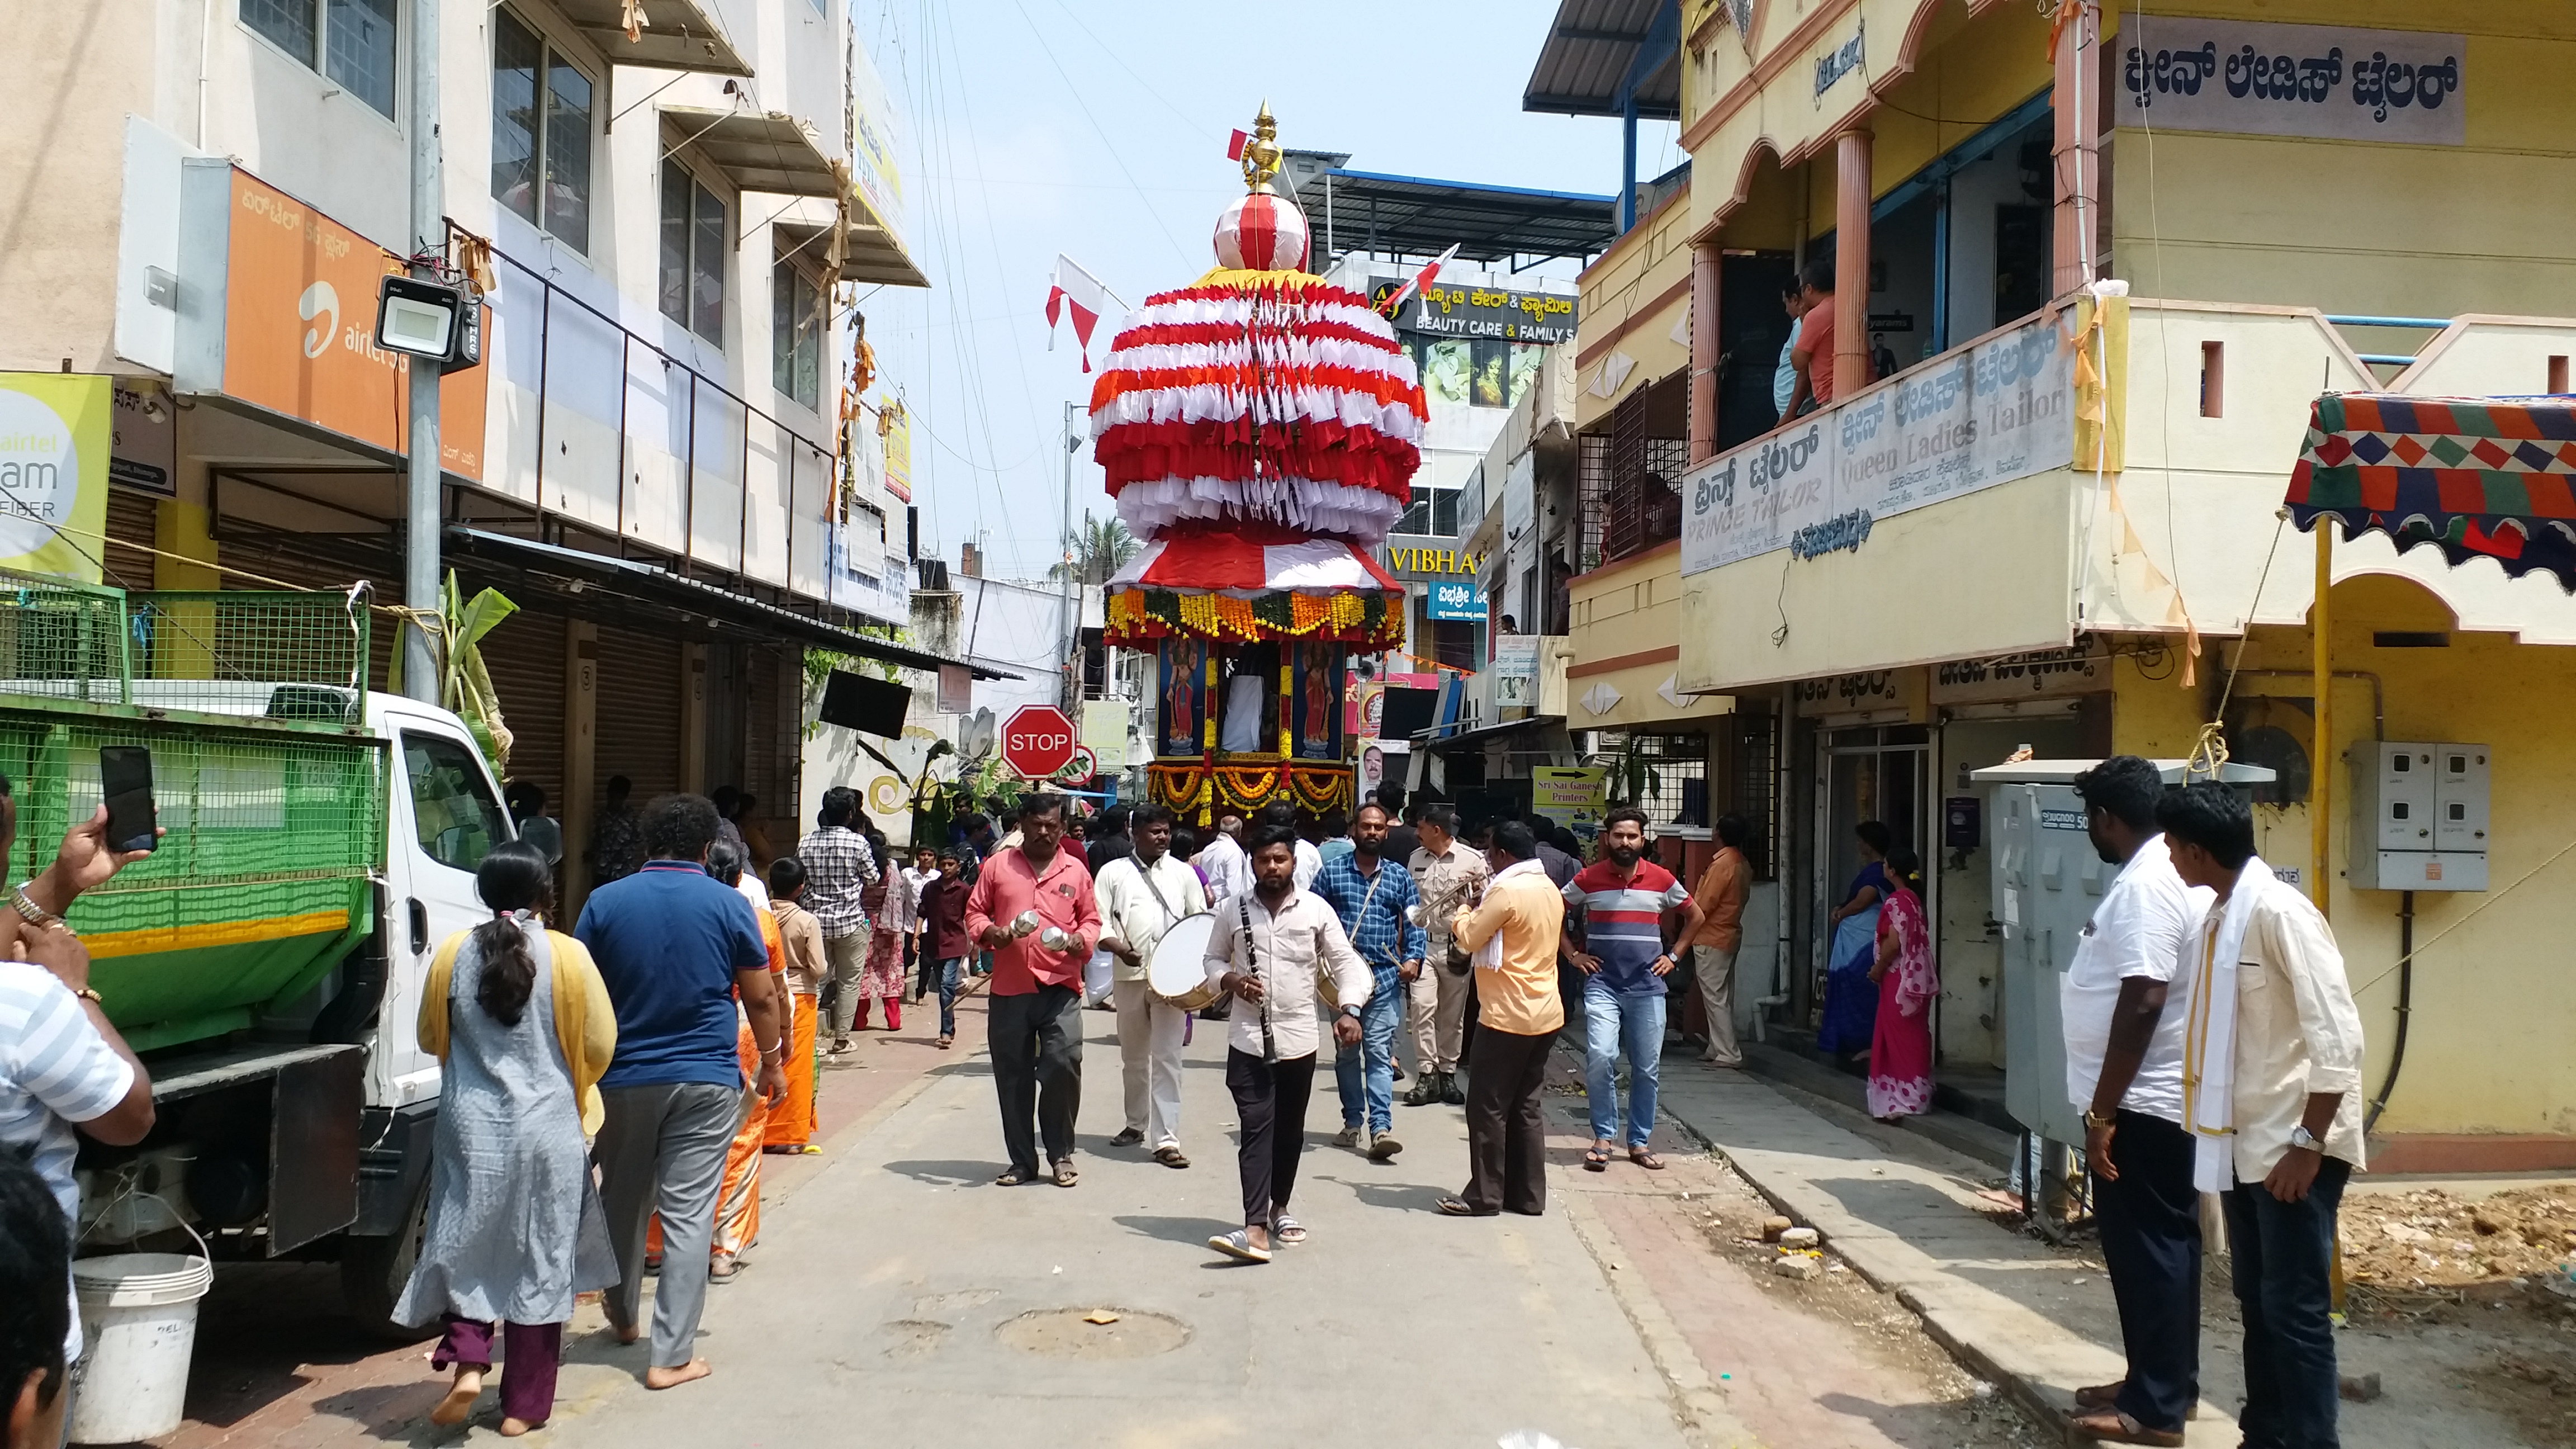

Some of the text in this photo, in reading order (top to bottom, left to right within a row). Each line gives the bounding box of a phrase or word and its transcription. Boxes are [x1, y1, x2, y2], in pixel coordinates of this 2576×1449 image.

[2125, 41, 2457, 123] ಕ್ವೀನ್ ಲೇಡಿಸ್ ಟೈಲರ್
[1471, 288, 1508, 307] ಕೇರ್
[1509, 295, 1518, 308] &
[1416, 315, 1466, 333] BEAUTY
[1469, 320, 1503, 336] CARE
[1506, 324, 1516, 337] &
[1519, 325, 1564, 342] FAMILY
[1, 432, 58, 452] airtel
[1841, 447, 1897, 494] Queen
[1906, 419, 1978, 466] Ladies
[1987, 387, 2066, 437] Tailor
[1750, 424, 1819, 495] ಟೈಲರ್
[0, 501, 55, 518] FIBER
[1687, 504, 1745, 546] PRINCE
[1752, 477, 1821, 523] TAILOR
[1388, 547, 1484, 574] VIBHA
[1011, 734, 1068, 751] STOP
[1554, 781, 1567, 789] Sai
[1570, 781, 1603, 790] Ganesh
[1552, 793, 1588, 802] Printers
